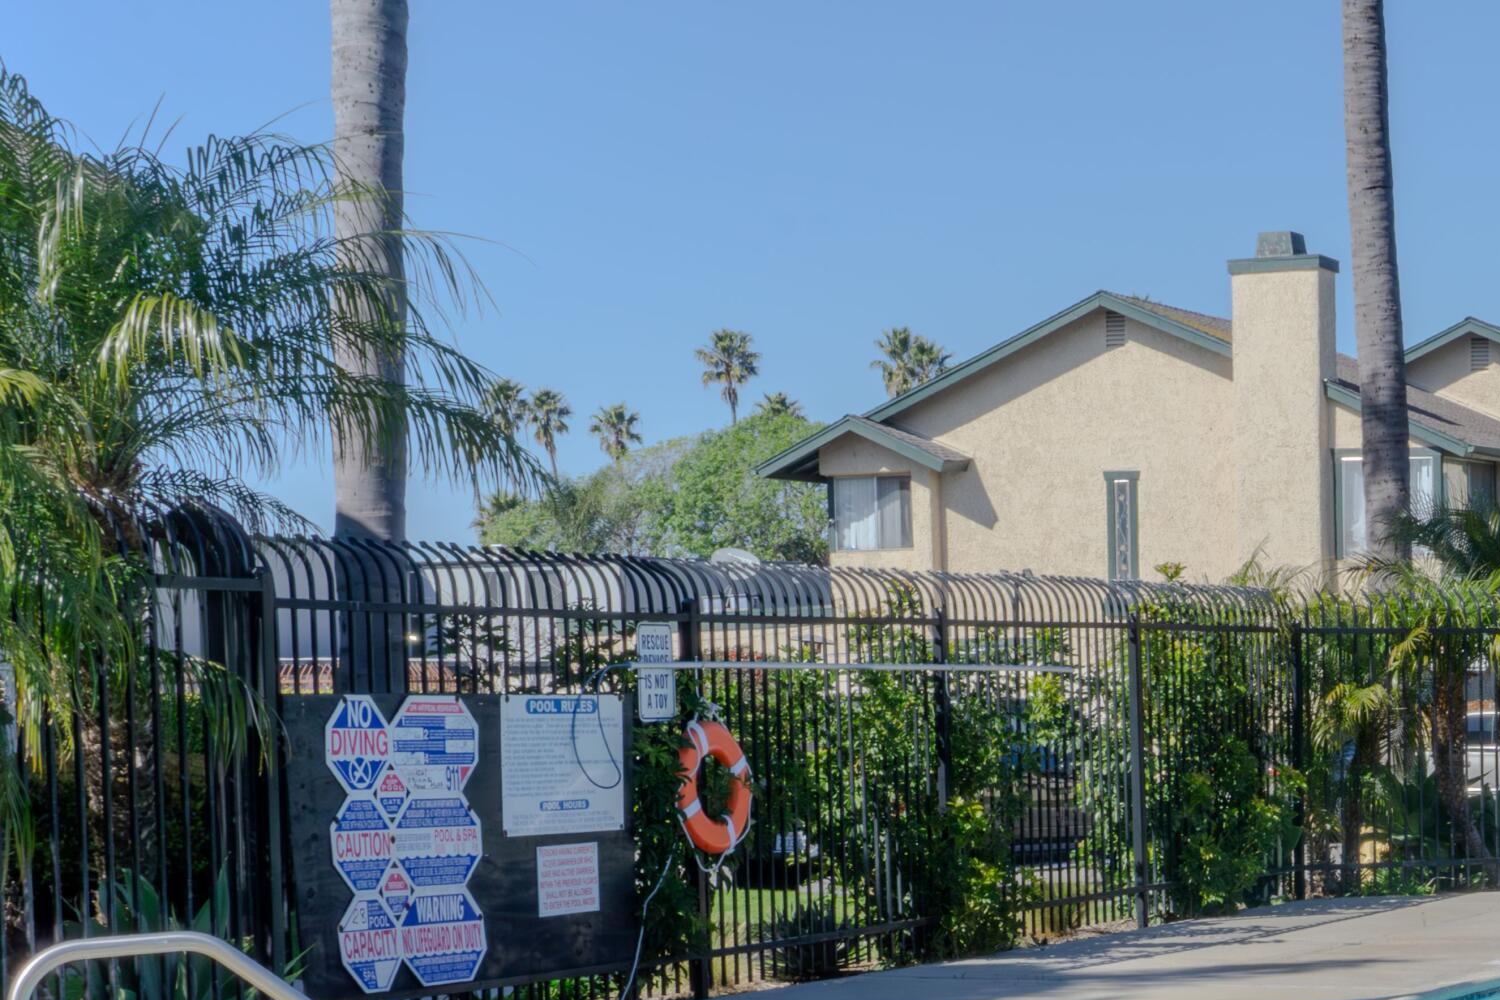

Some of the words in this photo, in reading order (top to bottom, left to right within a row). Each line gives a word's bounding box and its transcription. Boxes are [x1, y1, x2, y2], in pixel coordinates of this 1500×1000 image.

[642, 634, 669, 650] RESCUE
[645, 674, 652, 689] IS
[655, 674, 668, 688] NOT
[530, 701, 557, 712] POOL
[648, 694, 652, 708] A
[655, 693, 668, 708] TOY
[347, 700, 372, 728] NO
[331, 730, 388, 756] DIVING
[446, 766, 460, 791] 911
[336, 832, 391, 858] CAUTION
[434, 829, 454, 842] POOL
[463, 828, 477, 840] SPA
[416, 895, 464, 923] WARNING
[369, 916, 390, 928] POOL
[344, 929, 398, 960] CAPACITY
[402, 928, 414, 954] NO
[416, 926, 450, 952] LIFEGUARD
[452, 926, 462, 949] ON
[464, 924, 482, 948] DUTY
